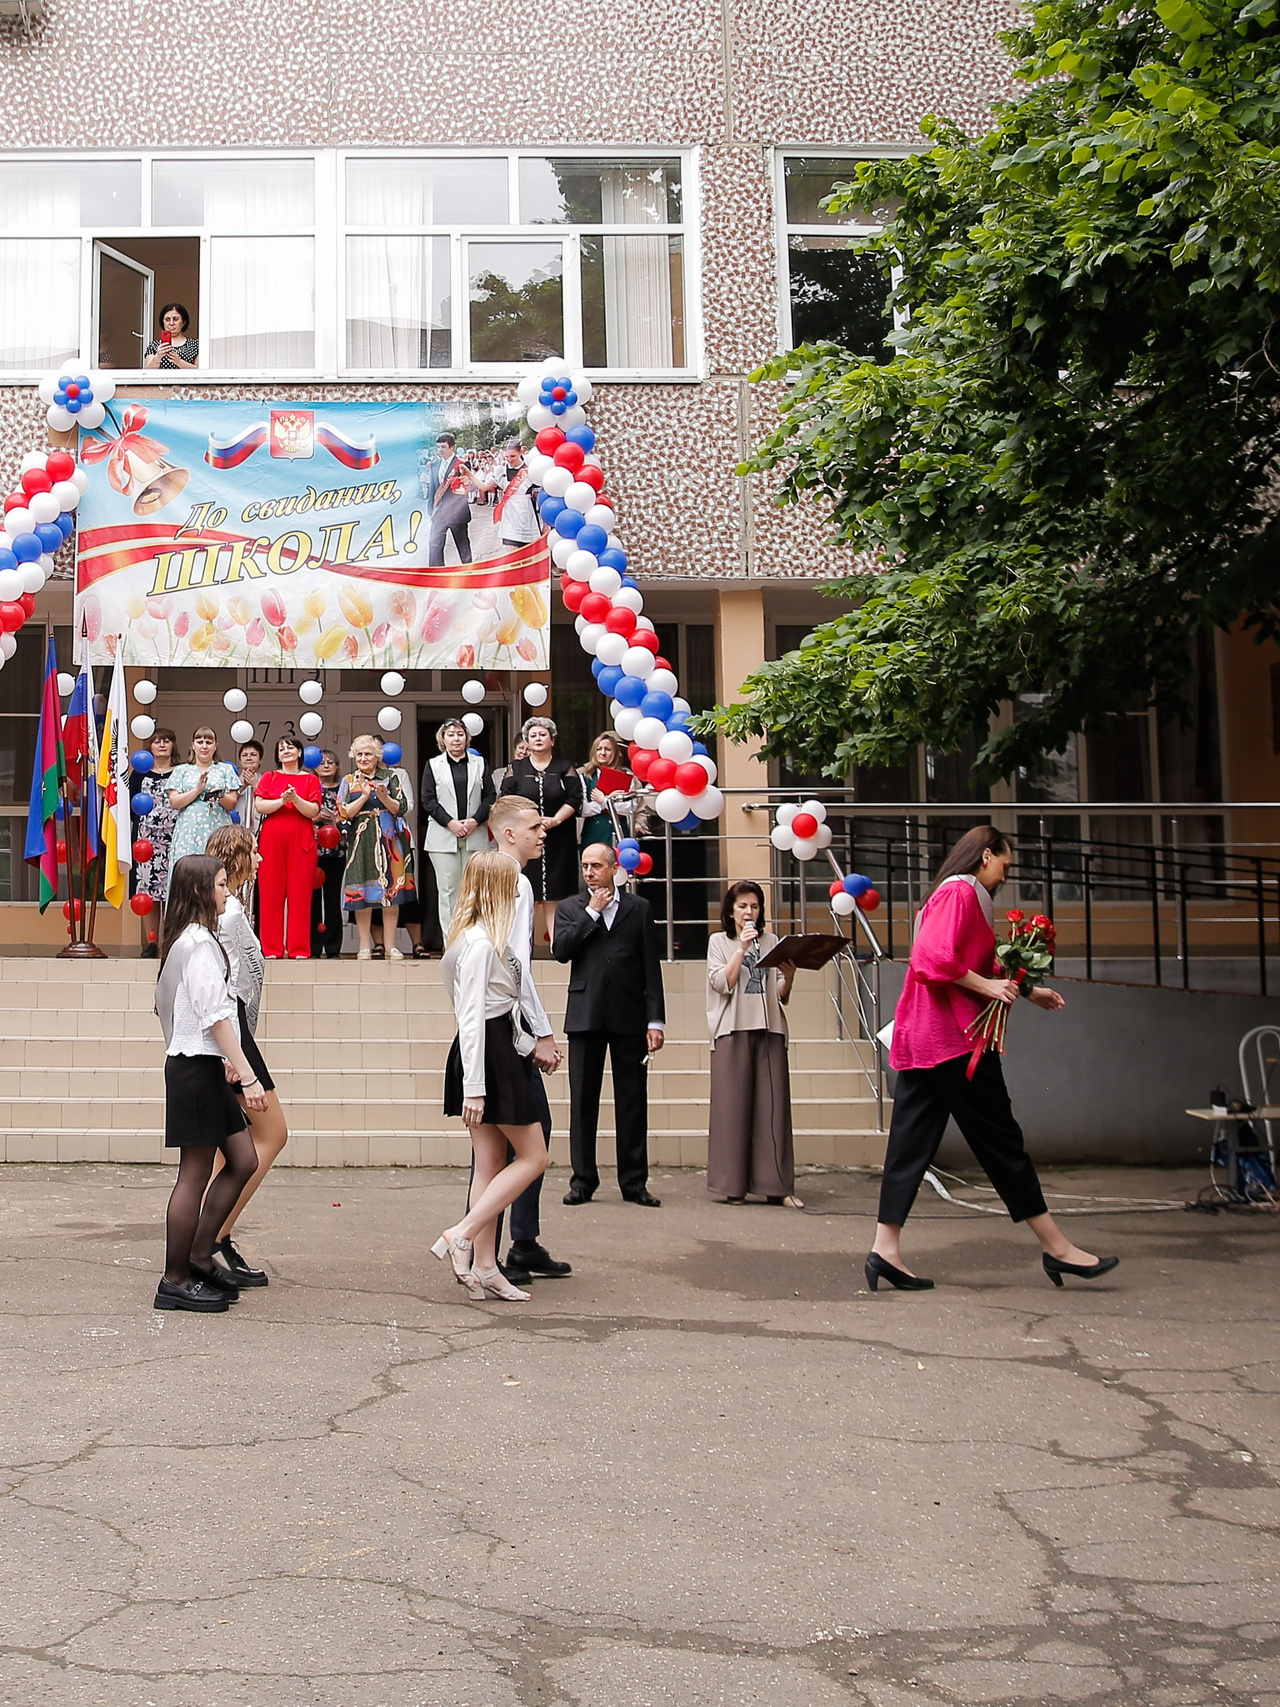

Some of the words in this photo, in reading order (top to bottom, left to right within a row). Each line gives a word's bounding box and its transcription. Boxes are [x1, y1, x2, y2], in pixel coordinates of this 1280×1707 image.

[173, 500, 228, 540] До
[240, 479, 402, 523] свидания,
[146, 510, 423, 597] ШКОЛА!
